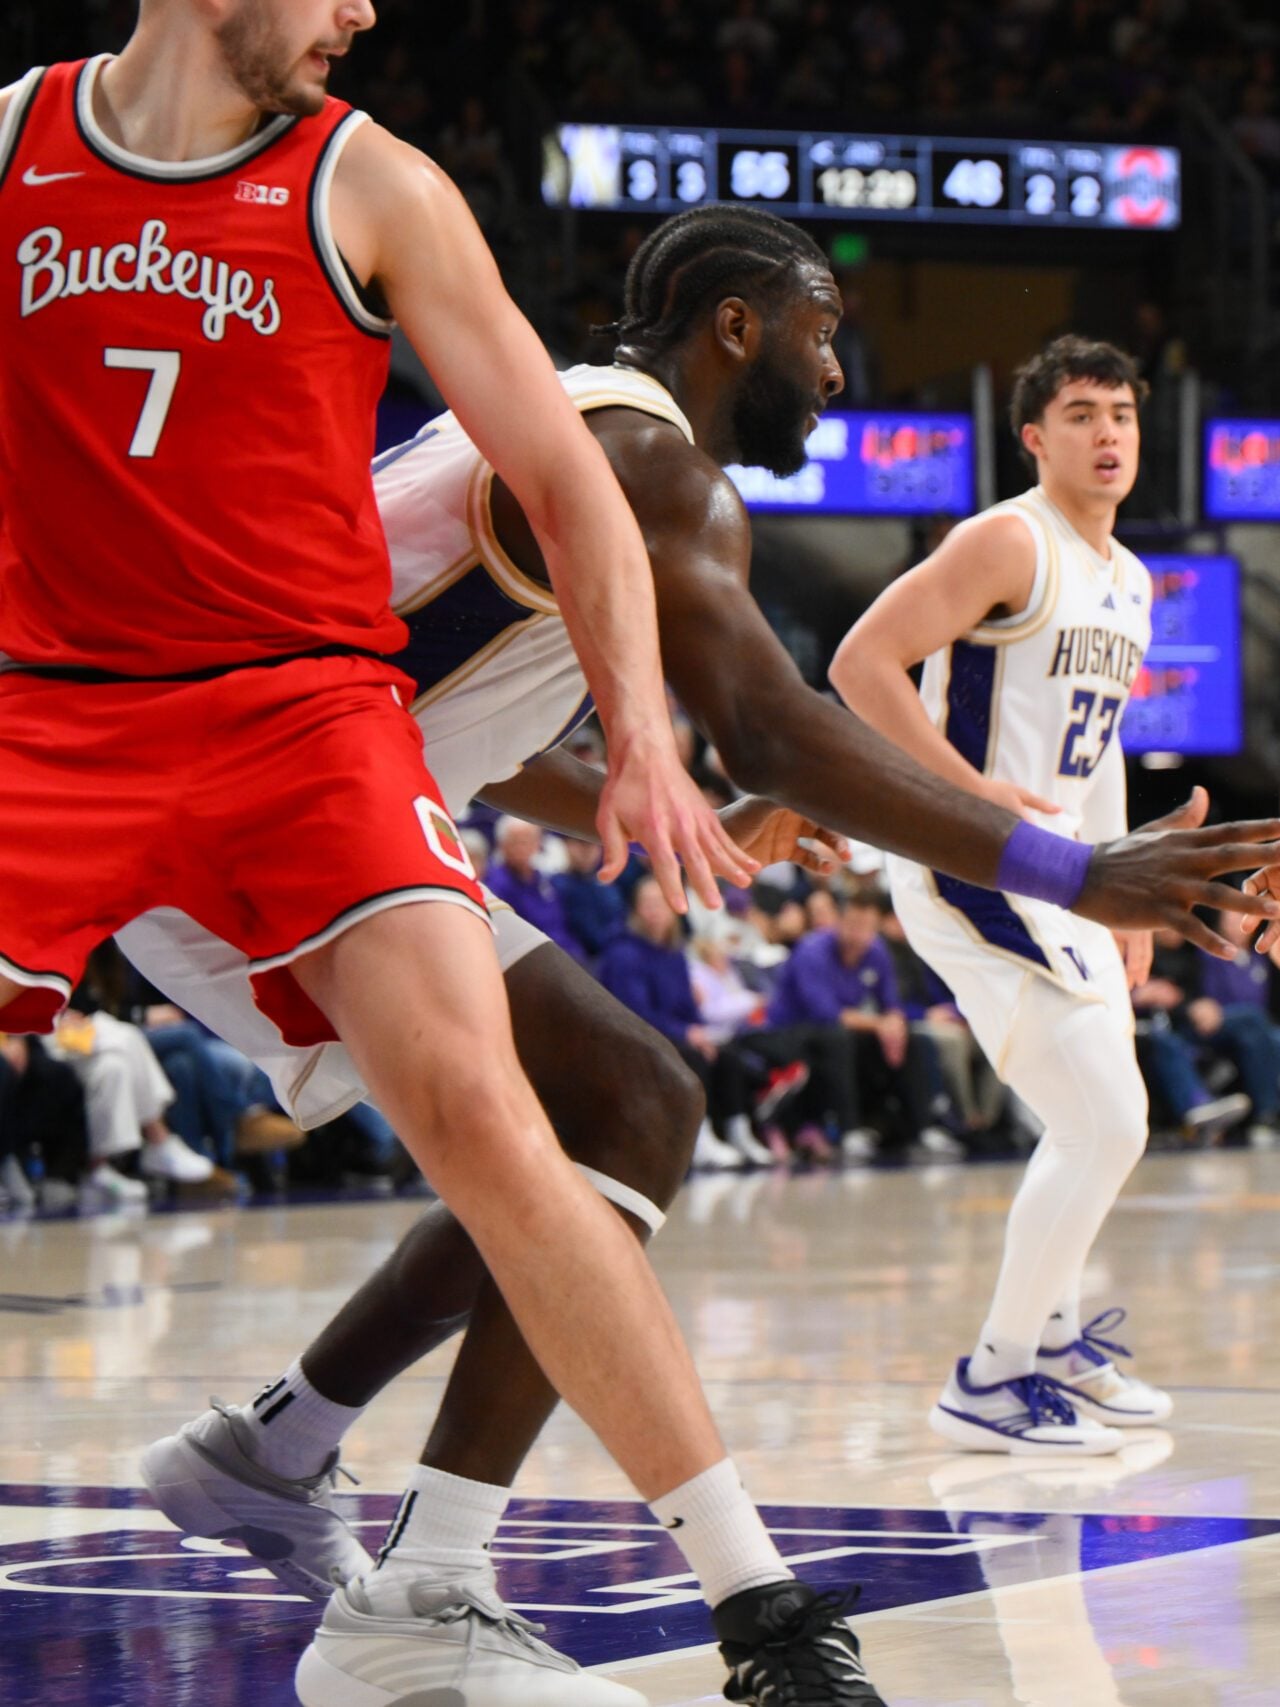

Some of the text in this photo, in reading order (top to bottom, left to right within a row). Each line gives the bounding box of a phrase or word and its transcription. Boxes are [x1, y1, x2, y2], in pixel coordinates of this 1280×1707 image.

[1025, 174, 1056, 215] 2
[1071, 176, 1101, 217] 2
[16, 218, 281, 341] Buckeyes
[103, 347, 181, 458] 7
[1046, 627, 1144, 690] HUSKIE
[1055, 684, 1123, 778] 23
